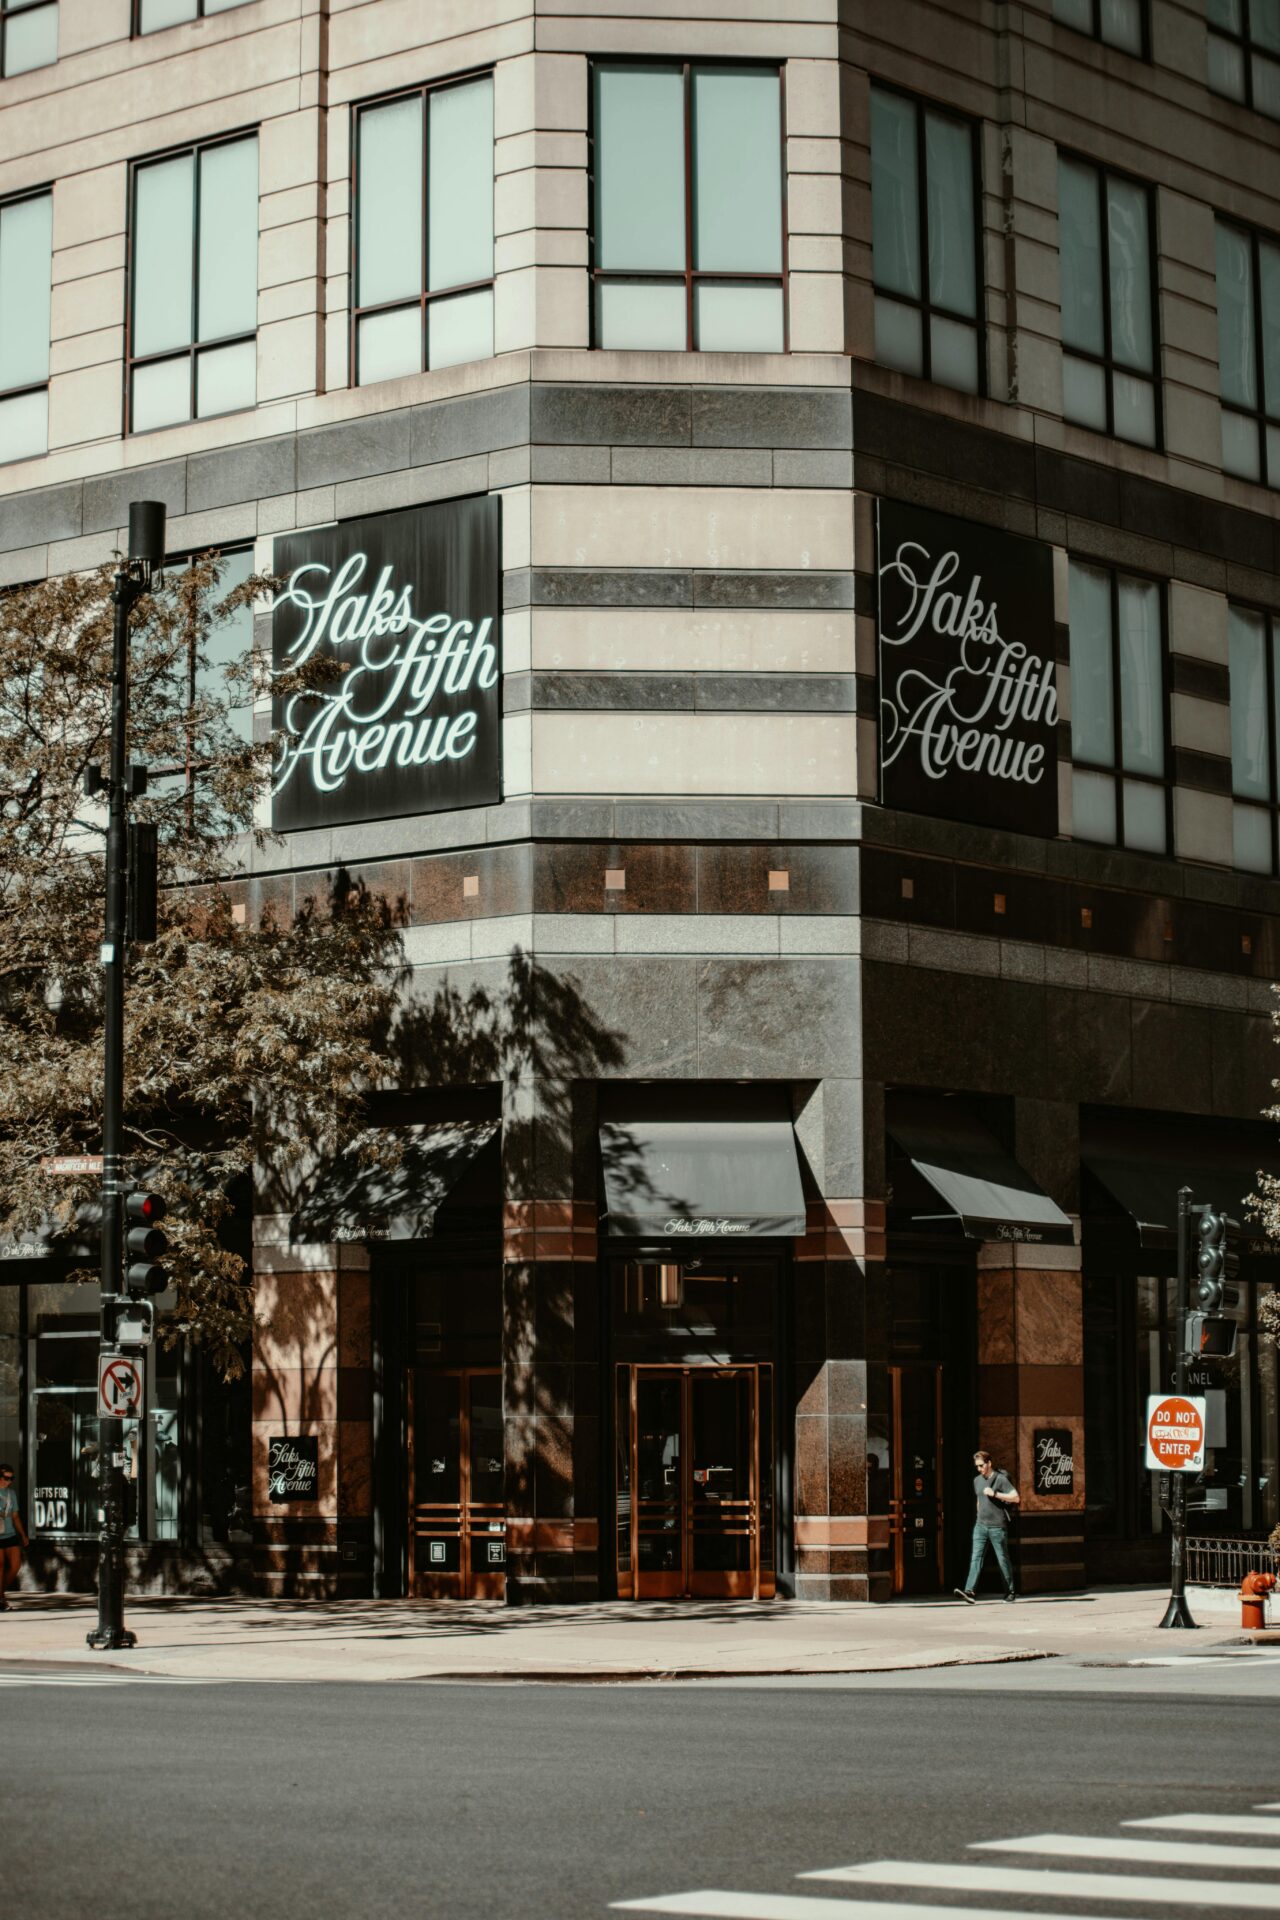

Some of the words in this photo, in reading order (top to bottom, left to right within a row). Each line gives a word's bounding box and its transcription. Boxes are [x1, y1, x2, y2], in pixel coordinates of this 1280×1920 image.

[879, 541, 998, 645] Saks
[271, 553, 413, 675] Saks
[343, 614, 498, 723] Fifth
[947, 627, 1059, 730] Fifth
[881, 669, 1045, 784] Avenue
[271, 690, 477, 796] Avenue
[664, 1219, 692, 1234] Saks
[688, 1219, 715, 1234] Fifth
[708, 1219, 750, 1234] Avenue
[1171, 1372, 1212, 1385] CANEL
[1156, 1411, 1171, 1423] DO
[1175, 1412, 1196, 1424] NOT
[268, 1443, 299, 1468] Saks
[1037, 1438, 1061, 1462] Saks
[1159, 1442, 1191, 1456] ENTER
[284, 1459, 316, 1481] Fifth
[1038, 1465, 1071, 1488] Avenue
[1050, 1454, 1073, 1475] Fifth
[34, 1487, 53, 1499] GIFTS
[54, 1487, 68, 1499] FOR
[268, 1470, 312, 1494] Avenue
[34, 1500, 68, 1528] DAD
